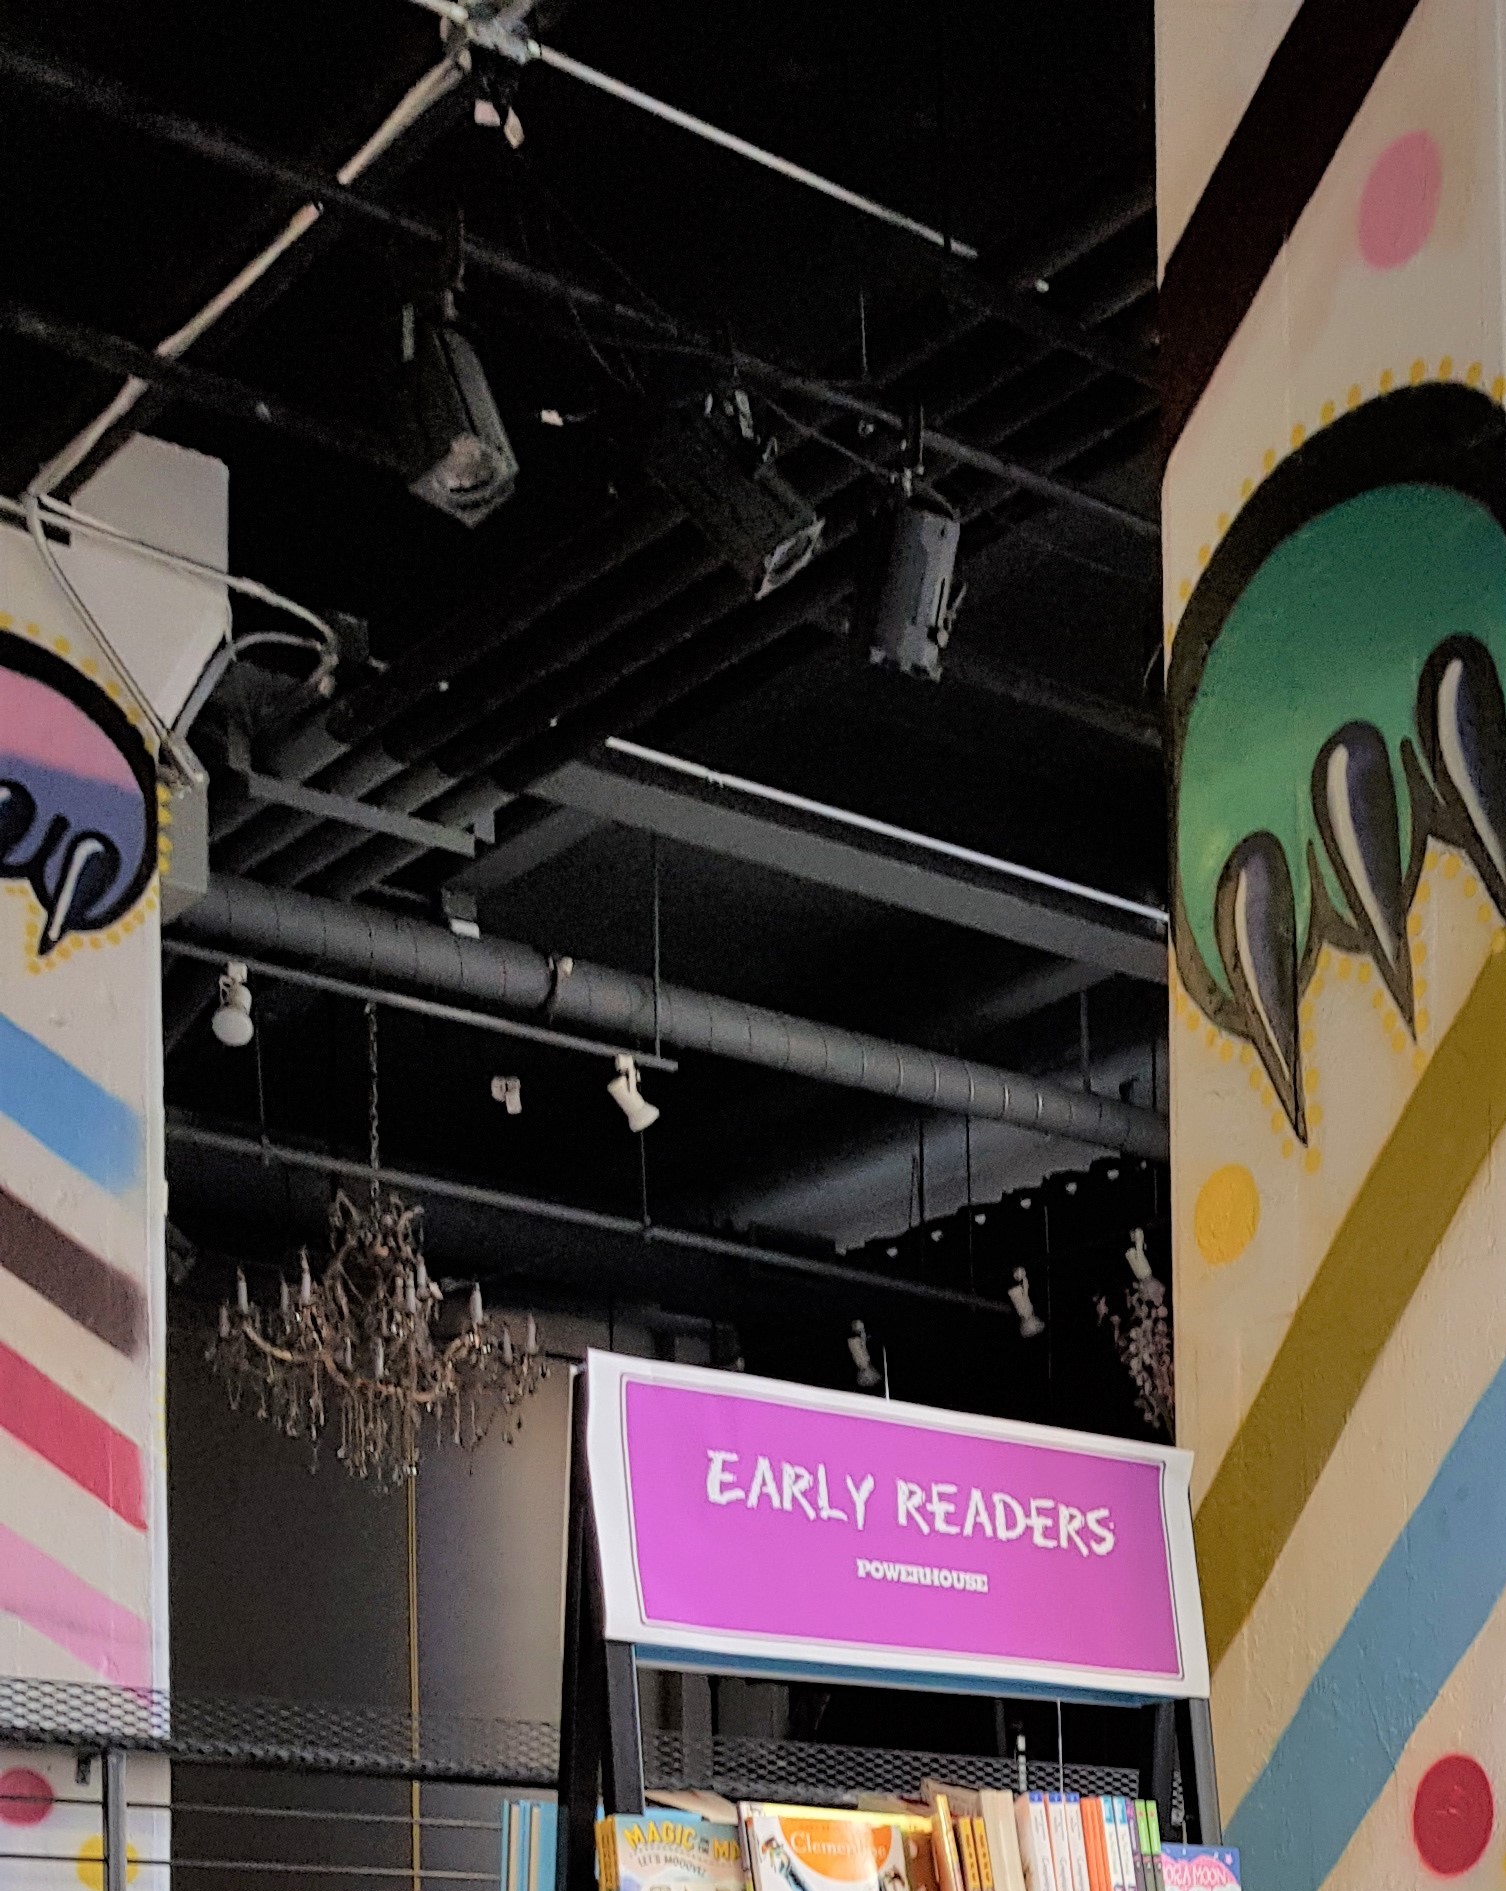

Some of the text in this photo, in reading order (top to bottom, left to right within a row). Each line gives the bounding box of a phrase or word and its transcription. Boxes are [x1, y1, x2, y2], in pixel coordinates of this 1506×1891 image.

[705, 1449, 1116, 1558] EARLY READERS
[856, 1557, 988, 1592] POWERHOUSE
[623, 1820, 697, 1850] MAGIC
[1193, 1864, 1227, 1886] MOON
